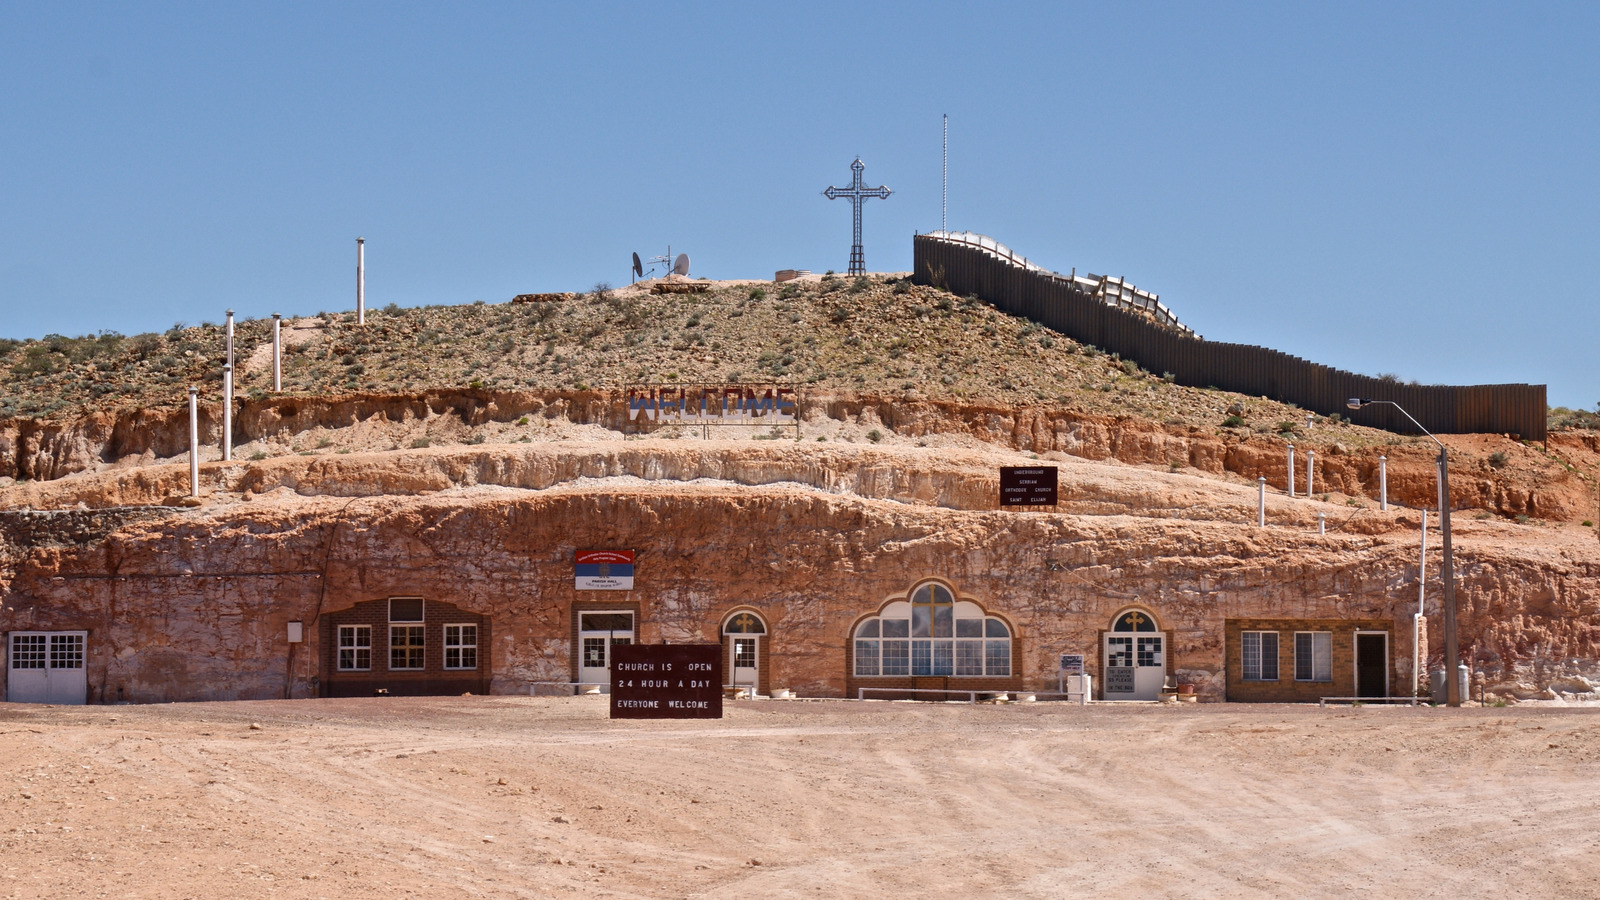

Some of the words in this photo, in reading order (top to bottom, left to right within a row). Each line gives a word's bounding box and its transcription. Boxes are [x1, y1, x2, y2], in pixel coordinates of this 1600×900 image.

[629, 388, 795, 421] WELCOME
[618, 663, 654, 671] CHURCH
[662, 663, 672, 671] IS
[688, 663, 712, 671] OPEN
[618, 680, 633, 688] 24
[641, 680, 668, 688] HOUR
[678, 680, 684, 688] A
[691, 680, 710, 688] DAY
[617, 699, 659, 709] EVERYONE
[668, 700, 709, 709] WELCOME
